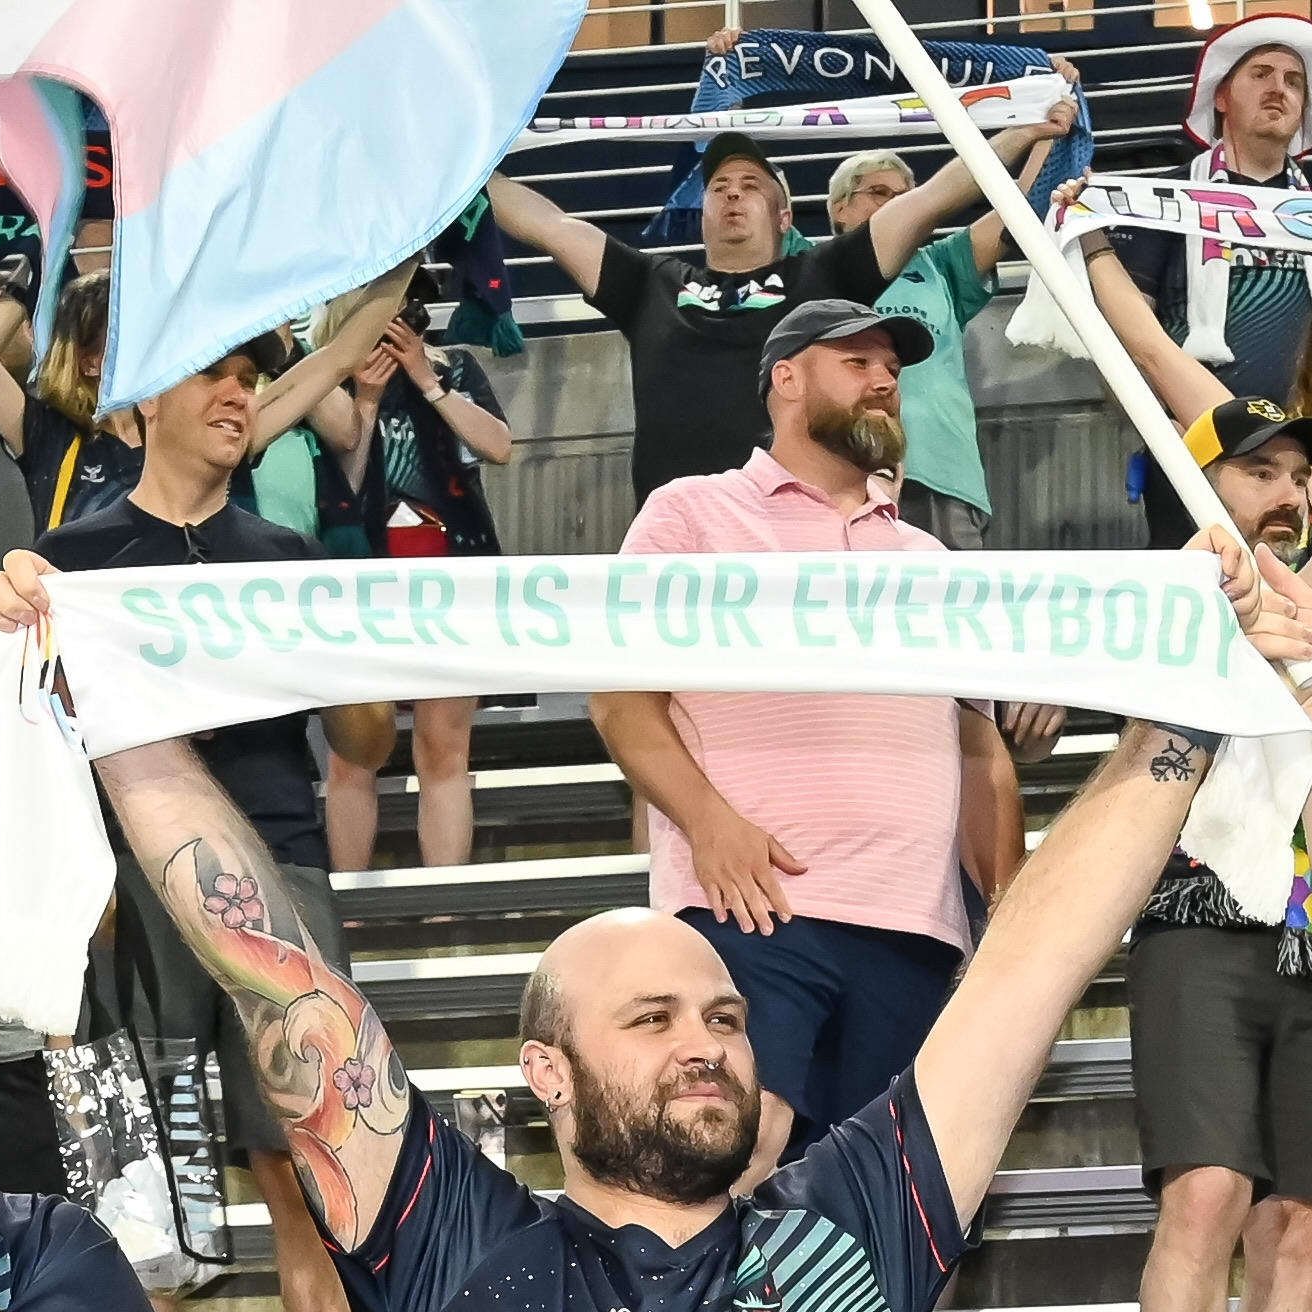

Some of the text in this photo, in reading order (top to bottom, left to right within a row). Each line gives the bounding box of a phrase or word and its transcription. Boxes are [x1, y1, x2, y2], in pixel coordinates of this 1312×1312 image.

[121, 560, 1238, 679] SOCCER IS FOR EVERYBODY
